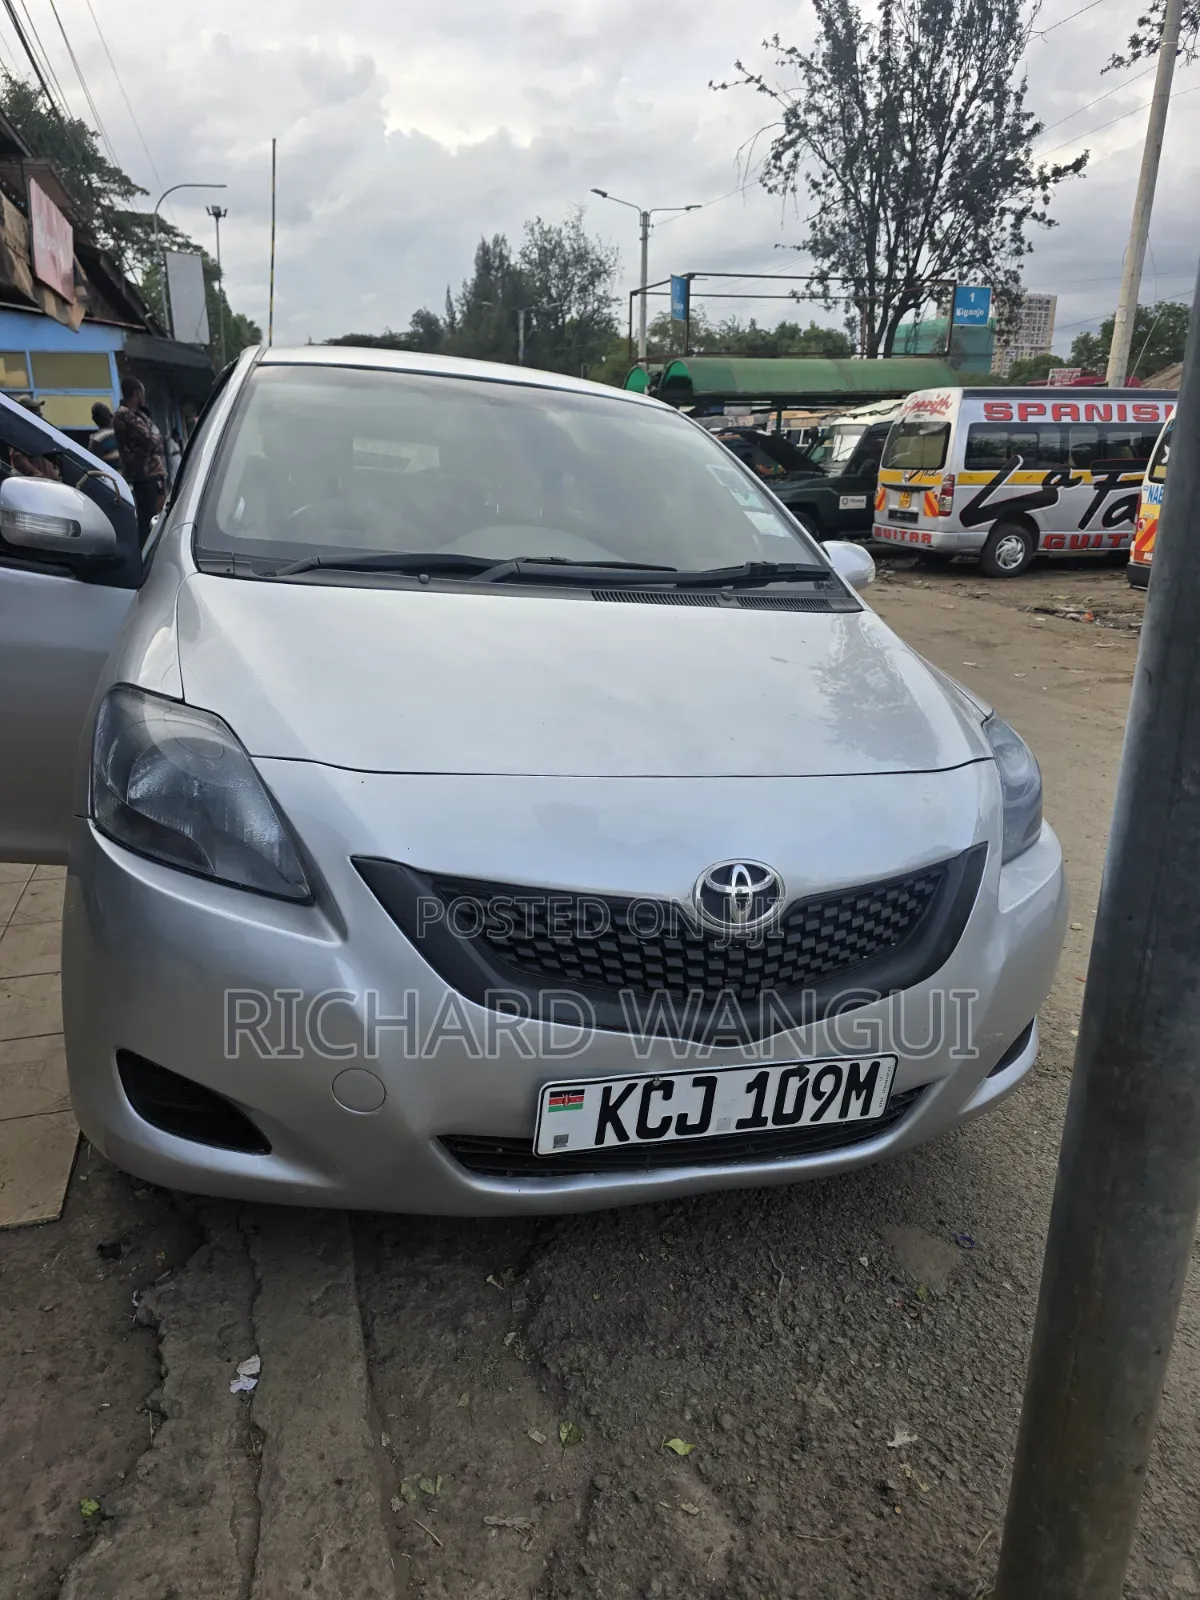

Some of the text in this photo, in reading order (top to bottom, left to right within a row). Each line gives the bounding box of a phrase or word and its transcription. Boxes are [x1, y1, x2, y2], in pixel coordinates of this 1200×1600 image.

[874, 526, 932, 544] GUITAR
[1043, 533, 1136, 549] GUIT
[594, 1075, 718, 1146] KCJ
[735, 1060, 881, 1130] 109M
